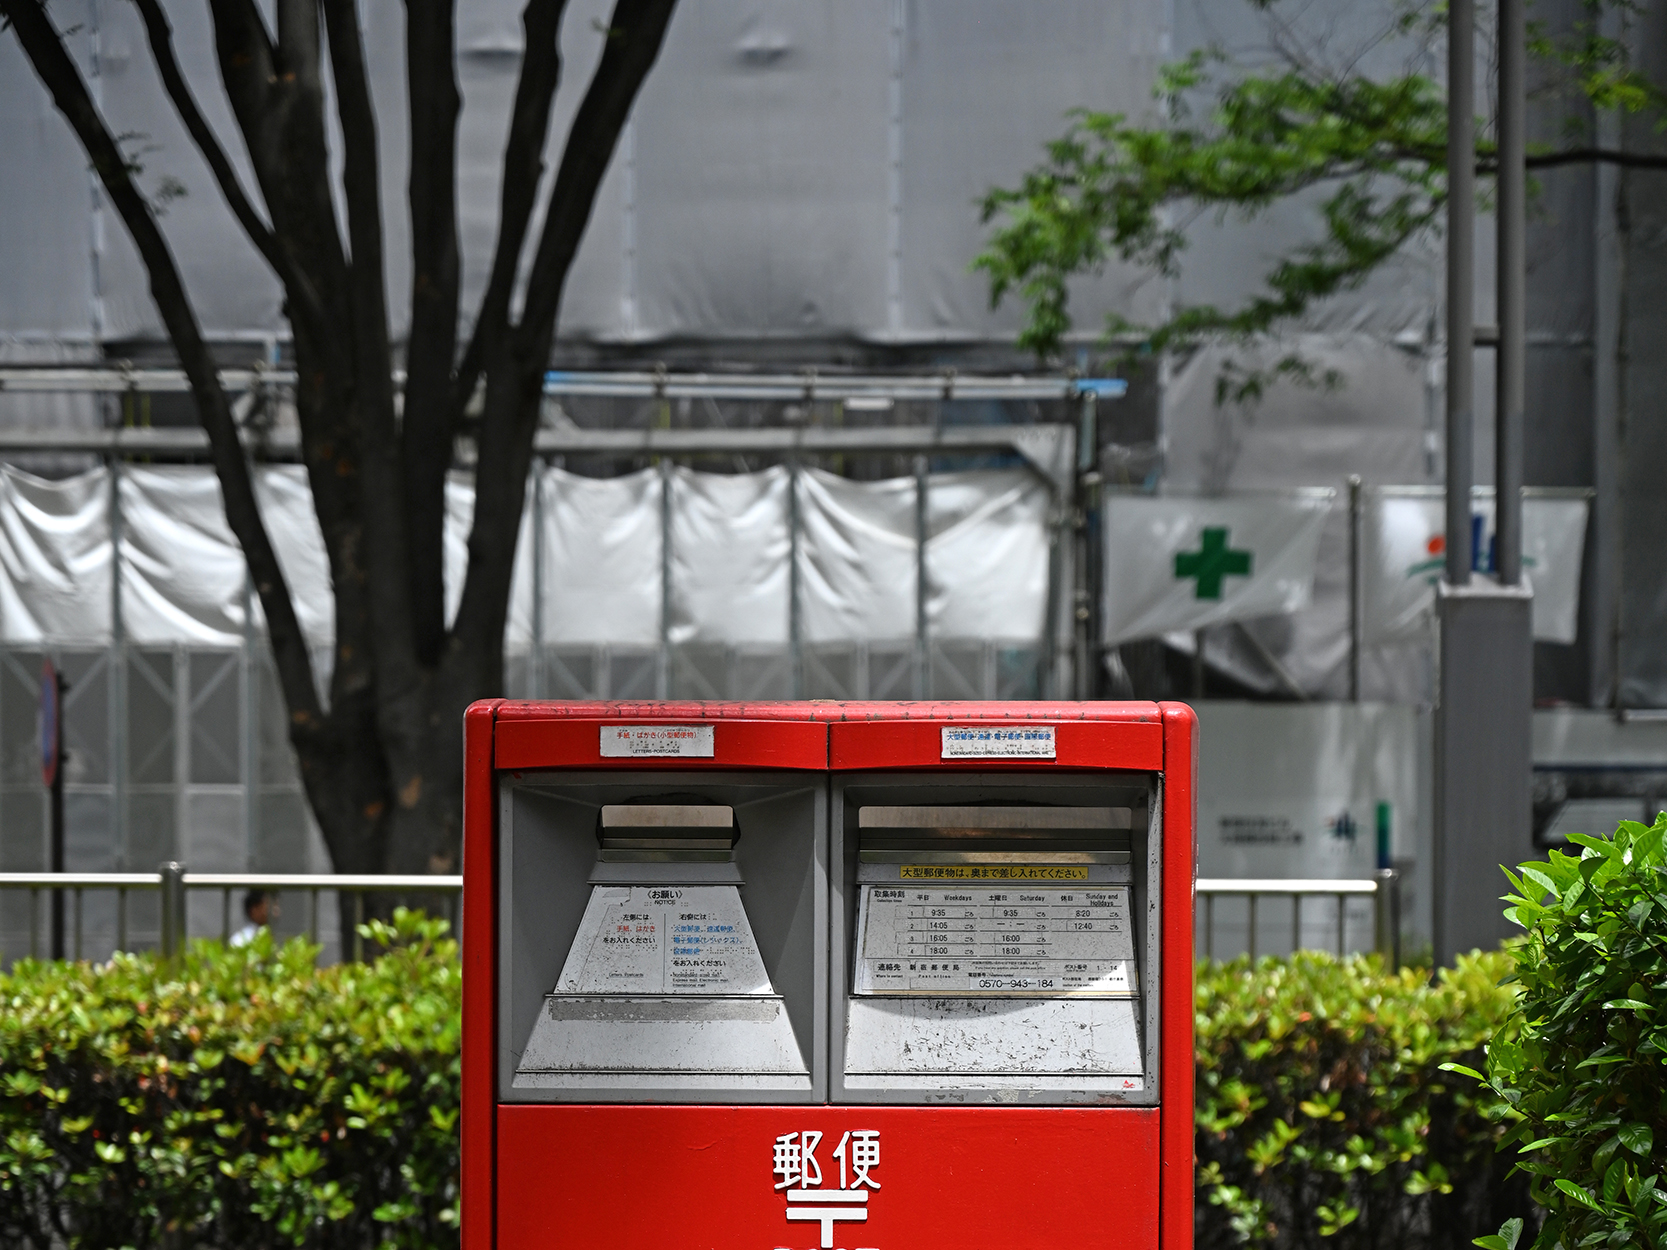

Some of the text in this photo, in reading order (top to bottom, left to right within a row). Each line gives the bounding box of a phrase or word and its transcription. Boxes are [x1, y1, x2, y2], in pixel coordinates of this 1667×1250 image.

[902, 868, 1086, 878] 大型郵便物は、奥まで差し入れてください。
[773, 1131, 881, 1189] 郵便
